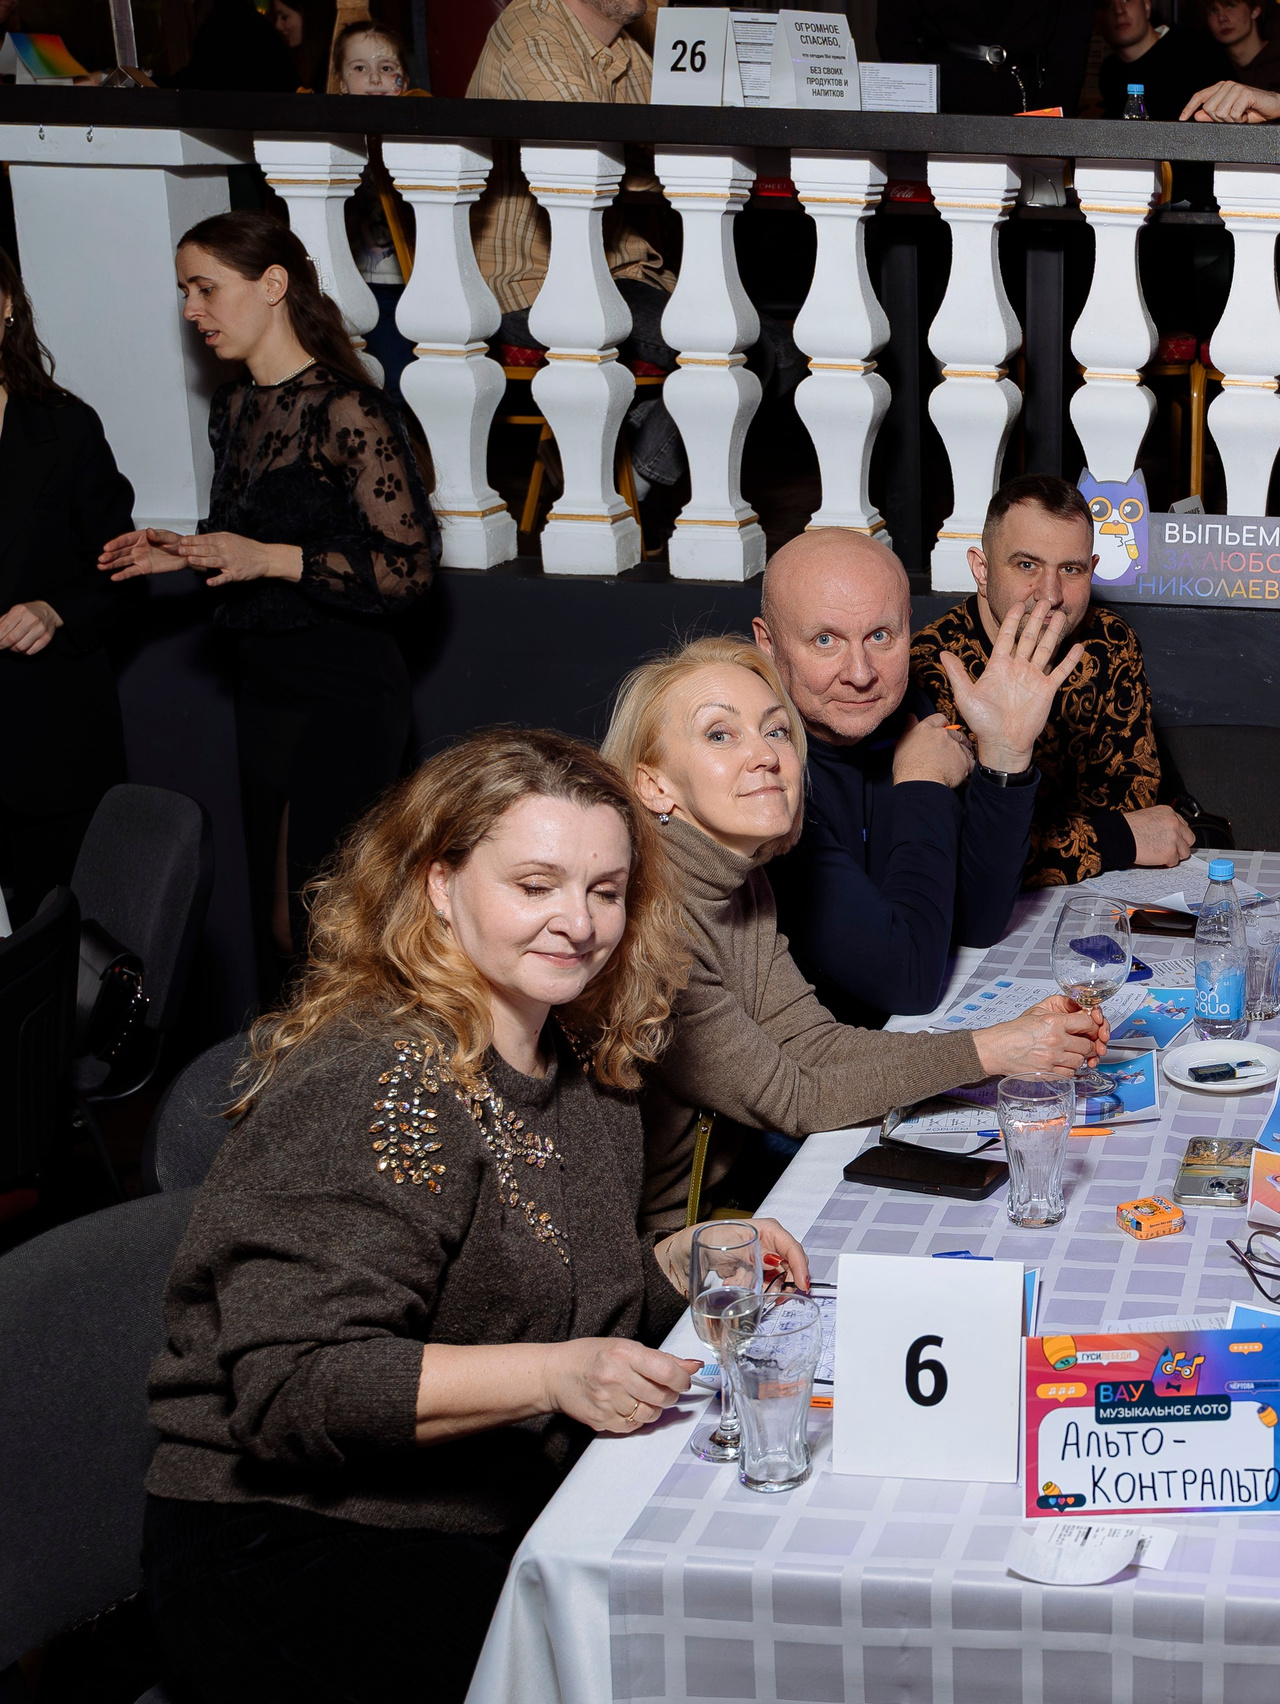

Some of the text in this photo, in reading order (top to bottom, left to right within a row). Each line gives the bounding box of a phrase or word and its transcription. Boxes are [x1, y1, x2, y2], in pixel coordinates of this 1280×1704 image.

[794, 22, 840, 35] ОГРОМНОЕ
[800, 35, 841, 48] СПАСИБО,
[670, 39, 707, 73] 26
[810, 66, 843, 76] БЕЗ СВОИХ
[806, 77, 849, 87] ПРОДУКТОВ И
[812, 89, 844, 98] НАПИТКОВ
[1164, 522, 1280, 547] ВЫПЬЕМ
[1162, 550, 1195, 571] ЗА
[905, 1334, 948, 1407] 6
[1100, 1383, 1145, 1403] ВАУ
[1100, 1404, 1229, 1419] МУЗЫКАЛЬНОЕ ЛОТО
